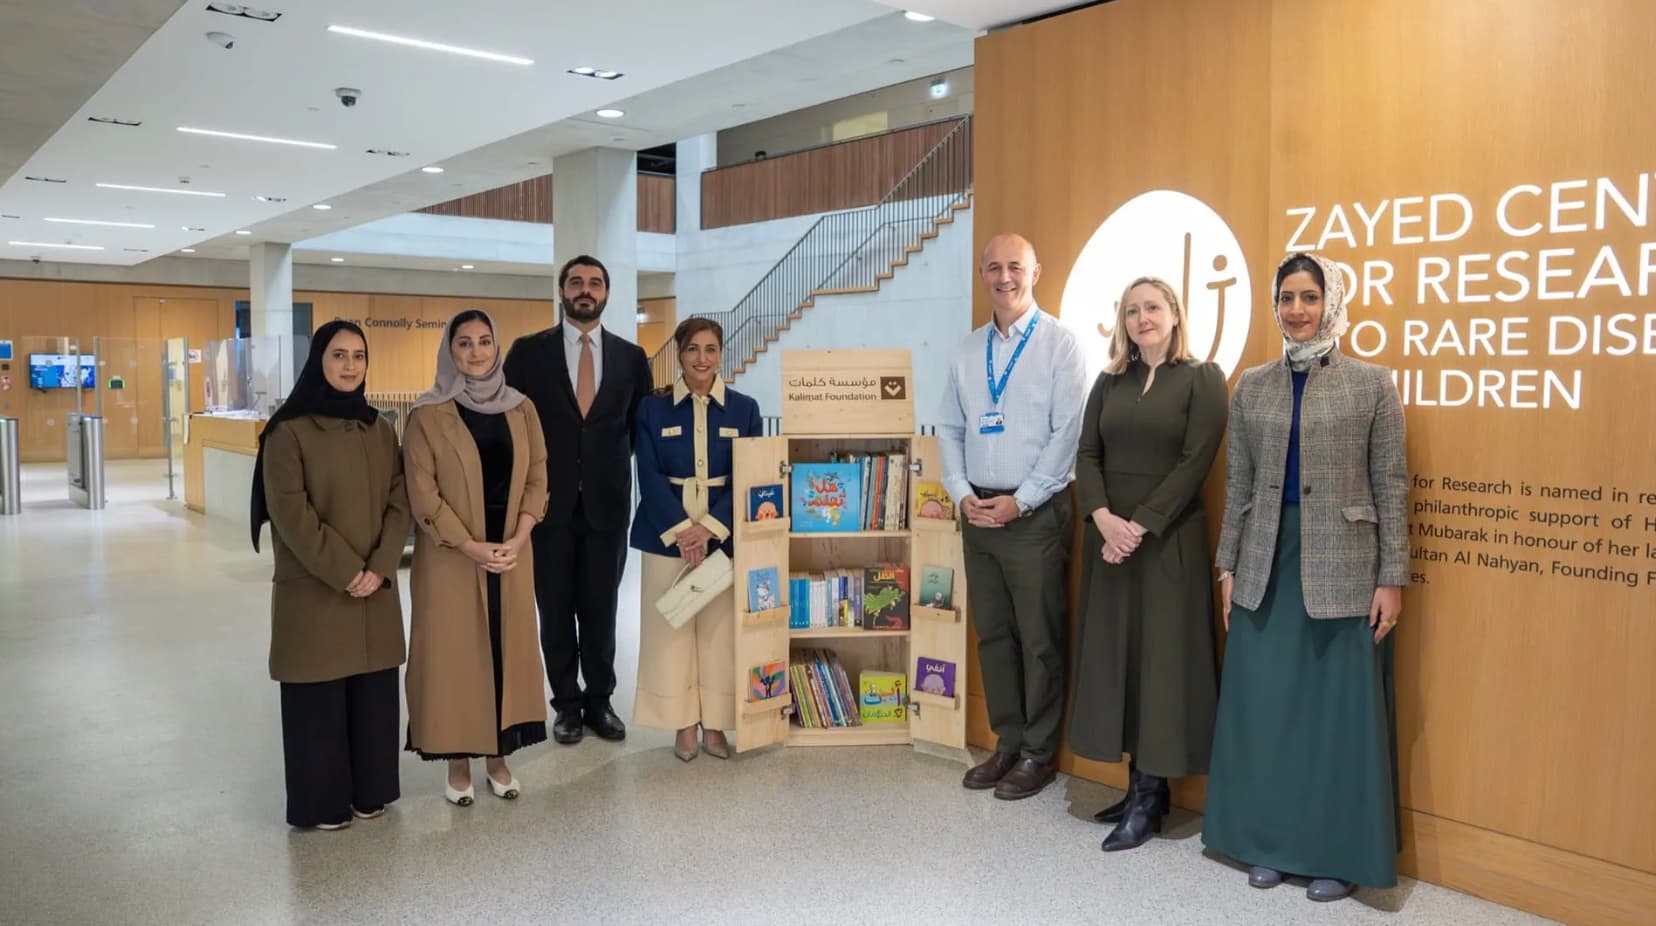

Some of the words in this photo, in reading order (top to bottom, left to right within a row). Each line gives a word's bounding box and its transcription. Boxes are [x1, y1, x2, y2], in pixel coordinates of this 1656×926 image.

[1285, 193, 1473, 253] ZAYED
[1496, 172, 1656, 238] CEN
[1337, 259, 1395, 306] OR
[364, 316, 413, 331] Connolly
[1403, 316, 1529, 357] RARE
[788, 376, 827, 388] كلمات
[788, 391, 823, 402] Kalimat
[825, 391, 877, 401] Foundation
[829, 376, 877, 390] مؤسسة
[1392, 368, 1582, 410] ILDREN
[1413, 475, 1435, 490] for
[1442, 477, 1512, 496] Research
[1520, 481, 1533, 497] is
[1540, 485, 1603, 502] named
[1612, 487, 1629, 504] in
[1414, 499, 1520, 523] philanthropic
[1529, 509, 1600, 529] support
[1611, 514, 1632, 530] of
[1418, 522, 1489, 543] Mubarak
[1494, 527, 1509, 545] in
[1514, 531, 1579, 551] honour
[1583, 538, 1604, 553] of
[1608, 540, 1640, 557] her
[1410, 545, 1448, 563] ultan
[1454, 551, 1471, 566] Al
[1477, 554, 1545, 576] Nahyan,
[1551, 560, 1639, 588] Founding
